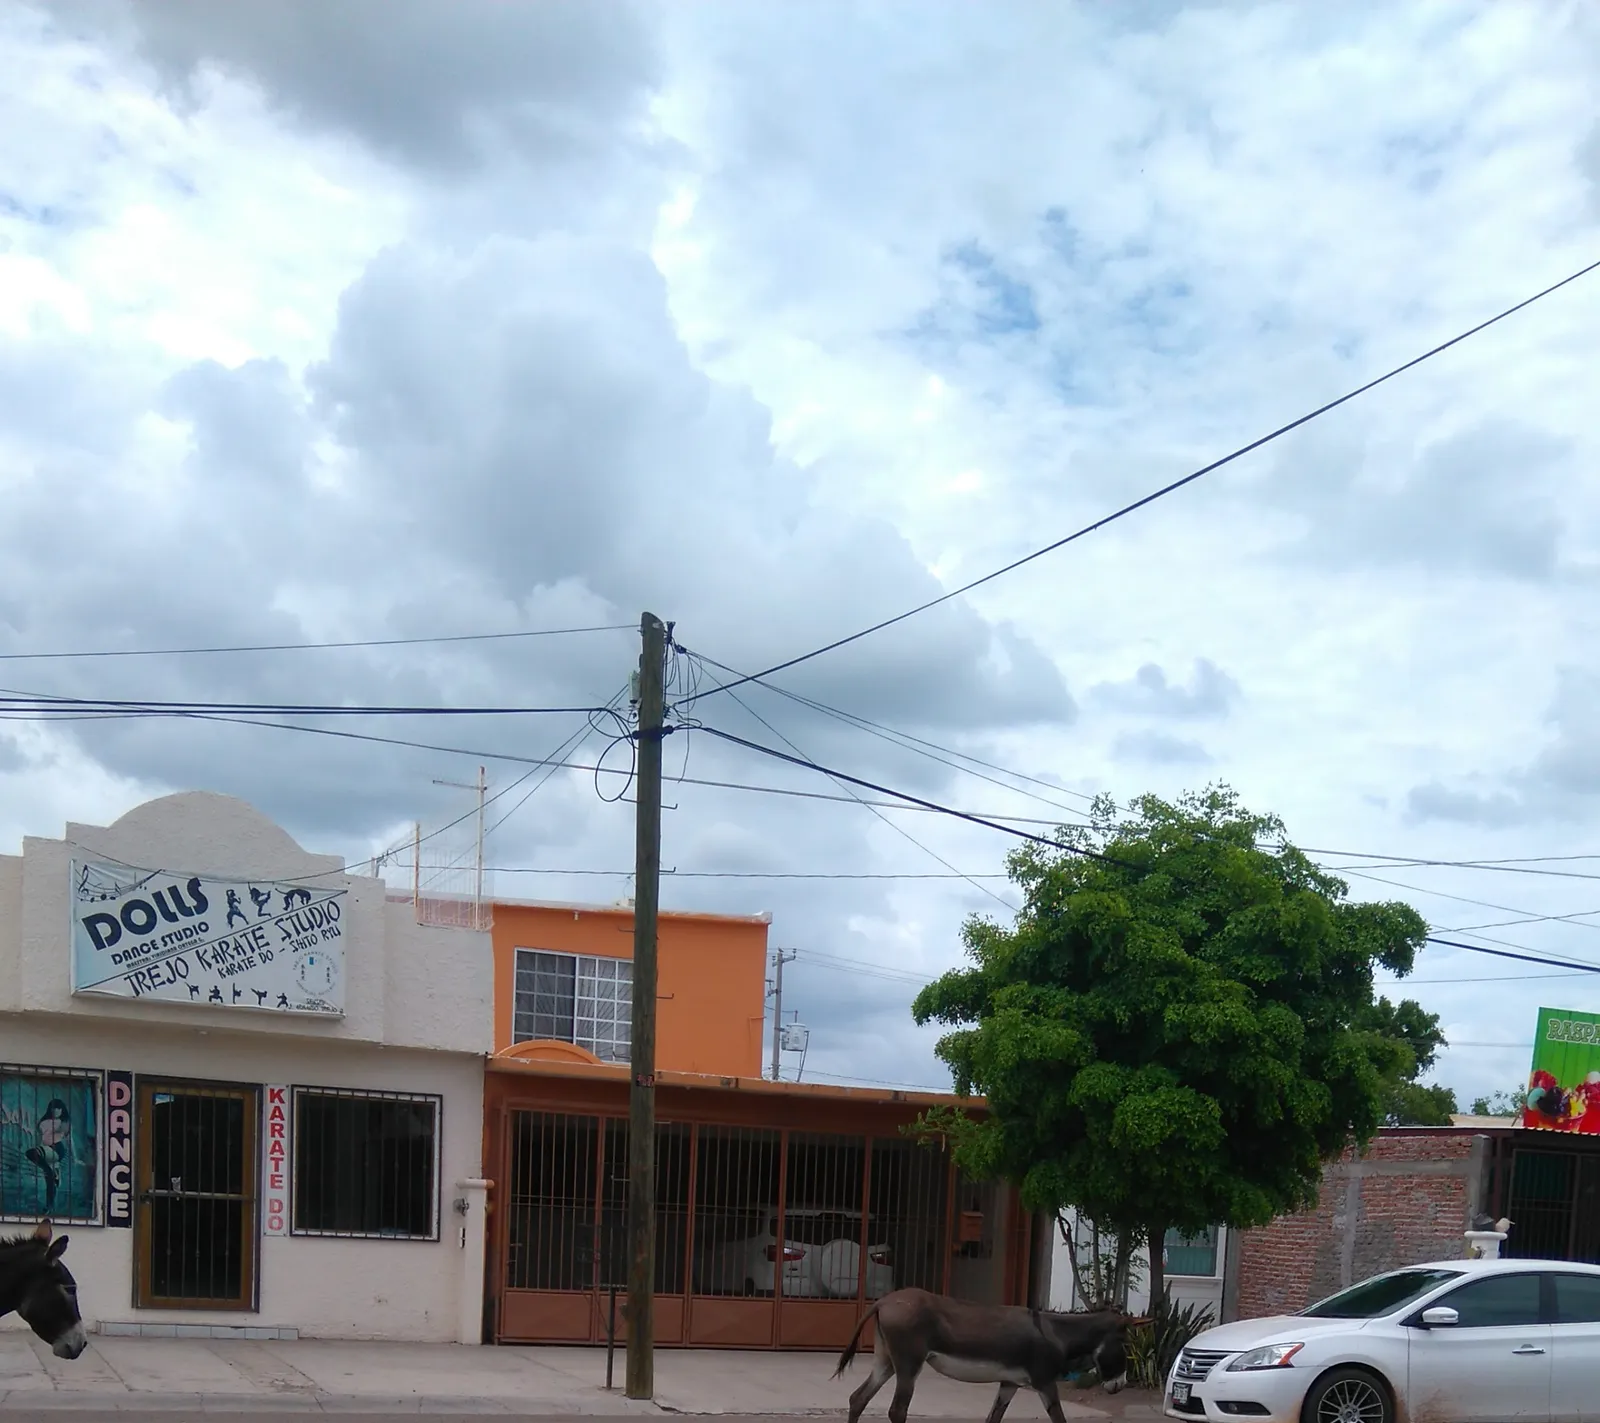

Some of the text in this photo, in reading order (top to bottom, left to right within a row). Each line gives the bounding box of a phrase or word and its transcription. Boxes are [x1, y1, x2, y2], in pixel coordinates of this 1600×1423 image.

[81, 877, 209, 951] DOLLS
[111, 921, 210, 966] DANCE STUDIO
[123, 956, 189, 998] TREJO
[194, 925, 271, 972] KARATE
[274, 900, 341, 942] STUDIO
[217, 957, 257, 980] KARATE
[260, 949, 274, 965] DO
[289, 935, 318, 954] SHITO
[322, 925, 342, 943] RYU
[109, 1080, 131, 1218] DANCE
[269, 1087, 286, 1232] KARATE DO
